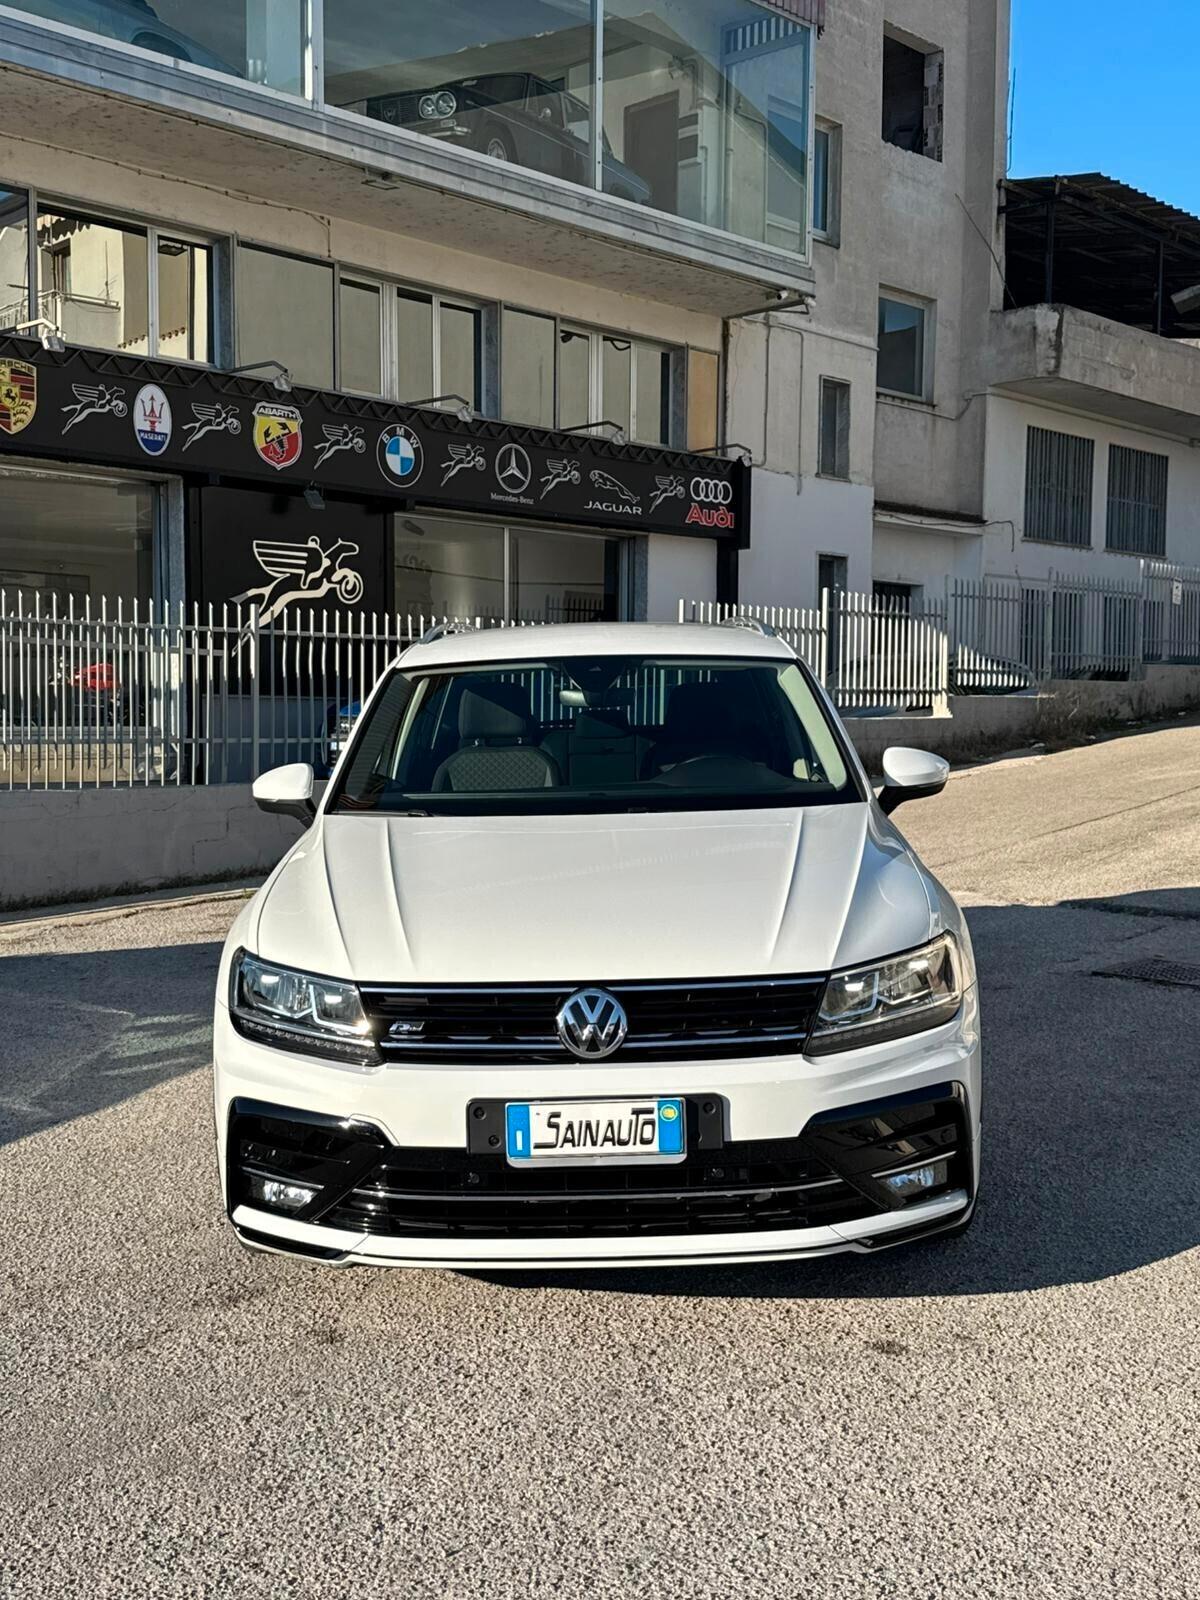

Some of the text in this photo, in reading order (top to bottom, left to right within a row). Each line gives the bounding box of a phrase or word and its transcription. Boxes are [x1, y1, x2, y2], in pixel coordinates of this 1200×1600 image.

[258, 406, 297, 419] ABARTH
[139, 431, 166, 443] MASERATI
[382, 426, 419, 448] BMW
[490, 492, 534, 504] Mercedes-Benz
[584, 500, 642, 515] JAGUAR
[685, 503, 734, 528] Audi
[533, 1107, 656, 1150] SAINAUTO
[515, 1130, 523, 1151] I
